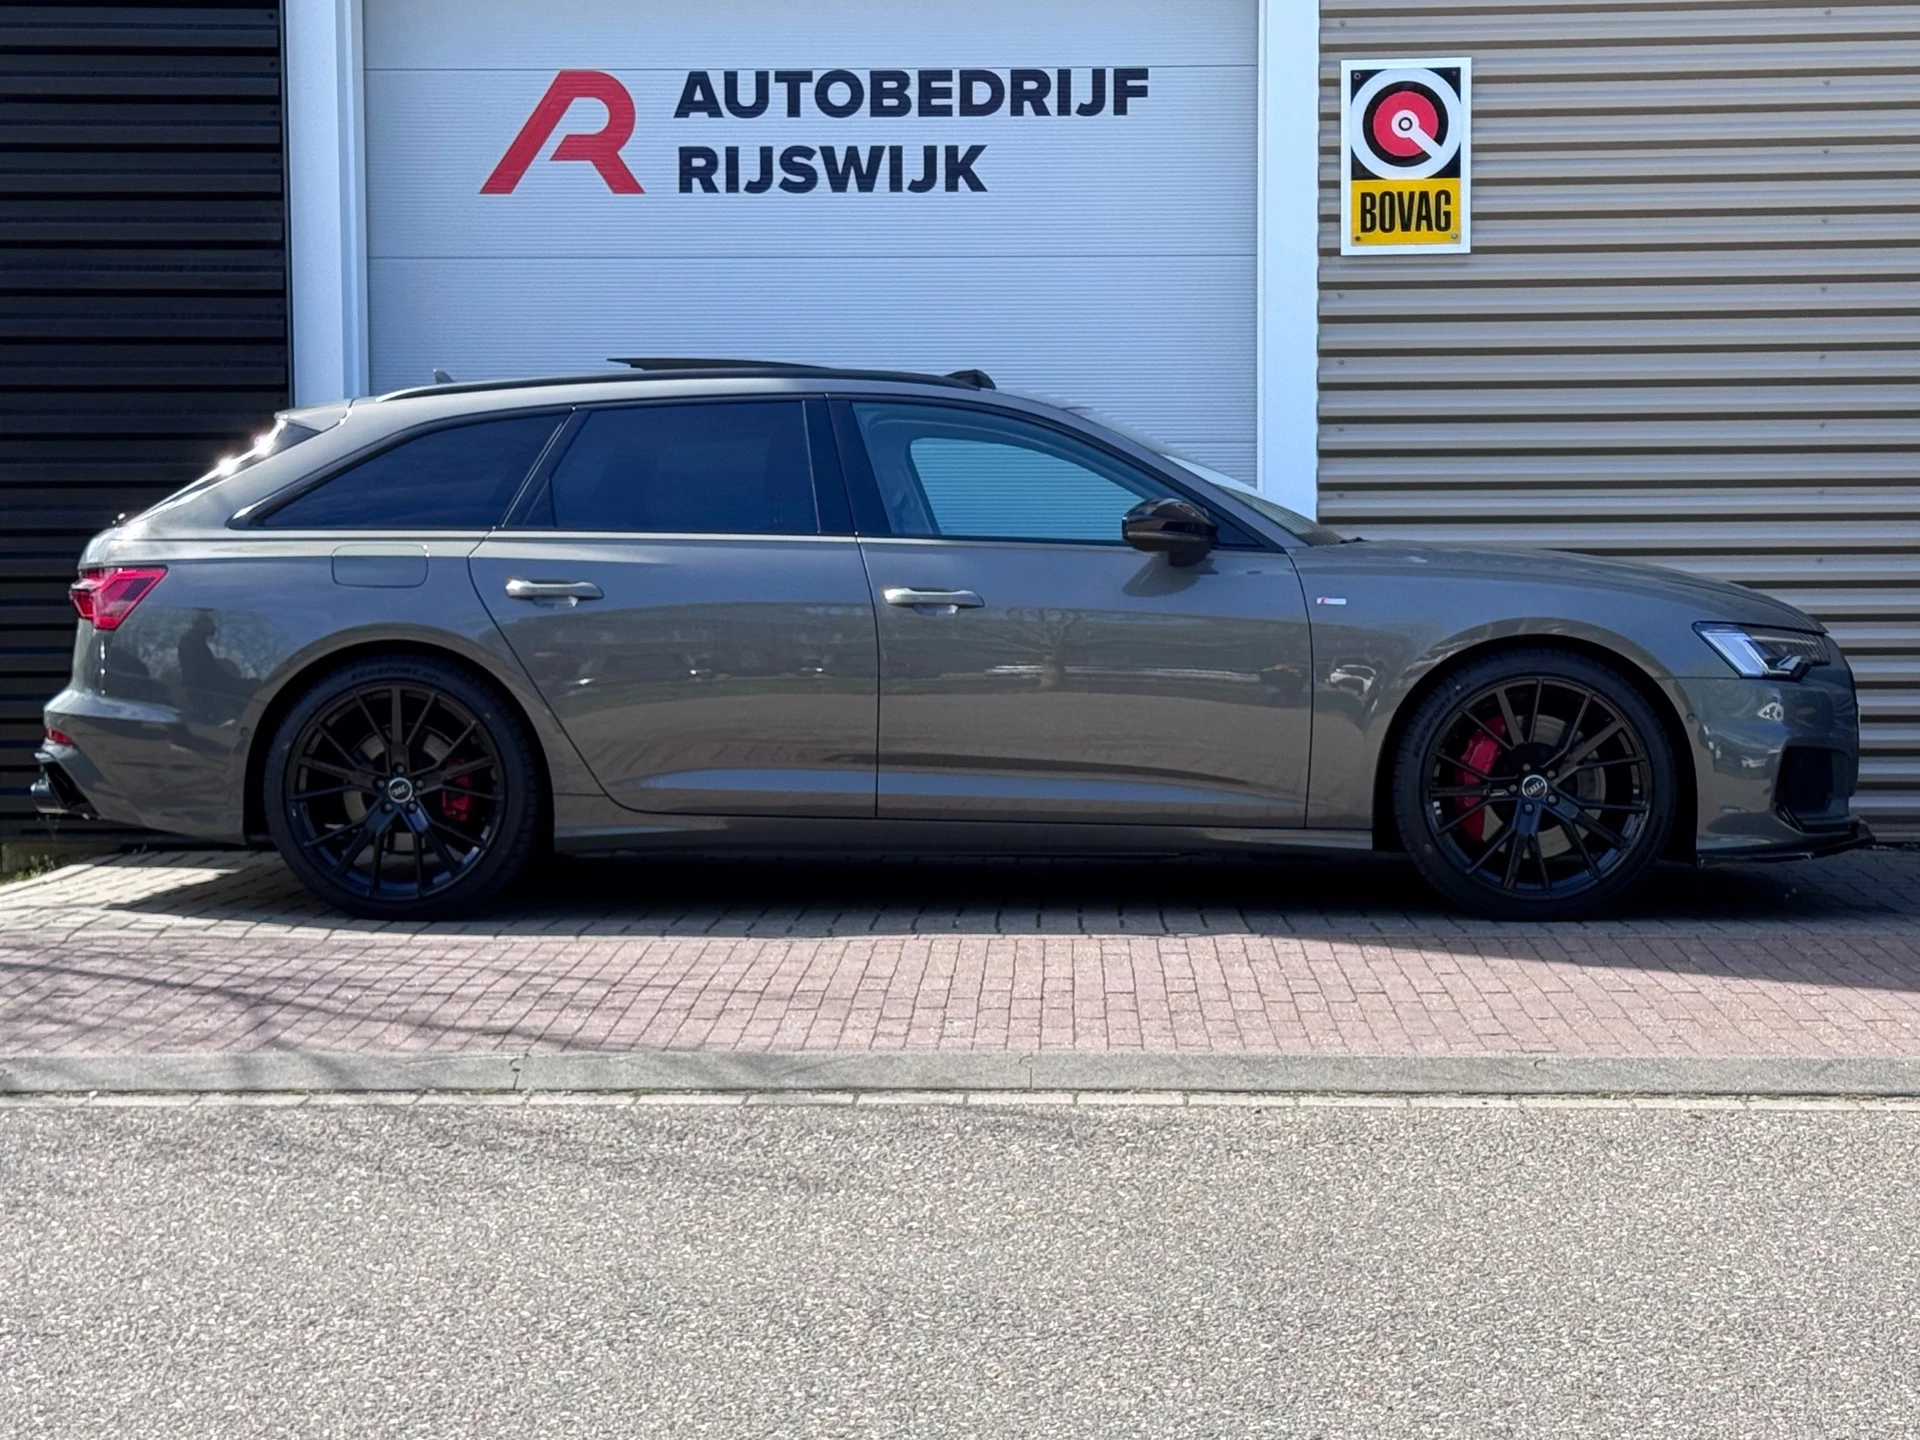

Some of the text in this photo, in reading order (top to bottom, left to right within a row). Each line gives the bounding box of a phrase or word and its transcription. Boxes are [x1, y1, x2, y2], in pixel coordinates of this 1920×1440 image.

[673, 67, 1149, 119] AUTOBEDRIJF
[678, 144, 988, 194] RIJSWIJK
[1360, 189, 1452, 233] BOVAG
